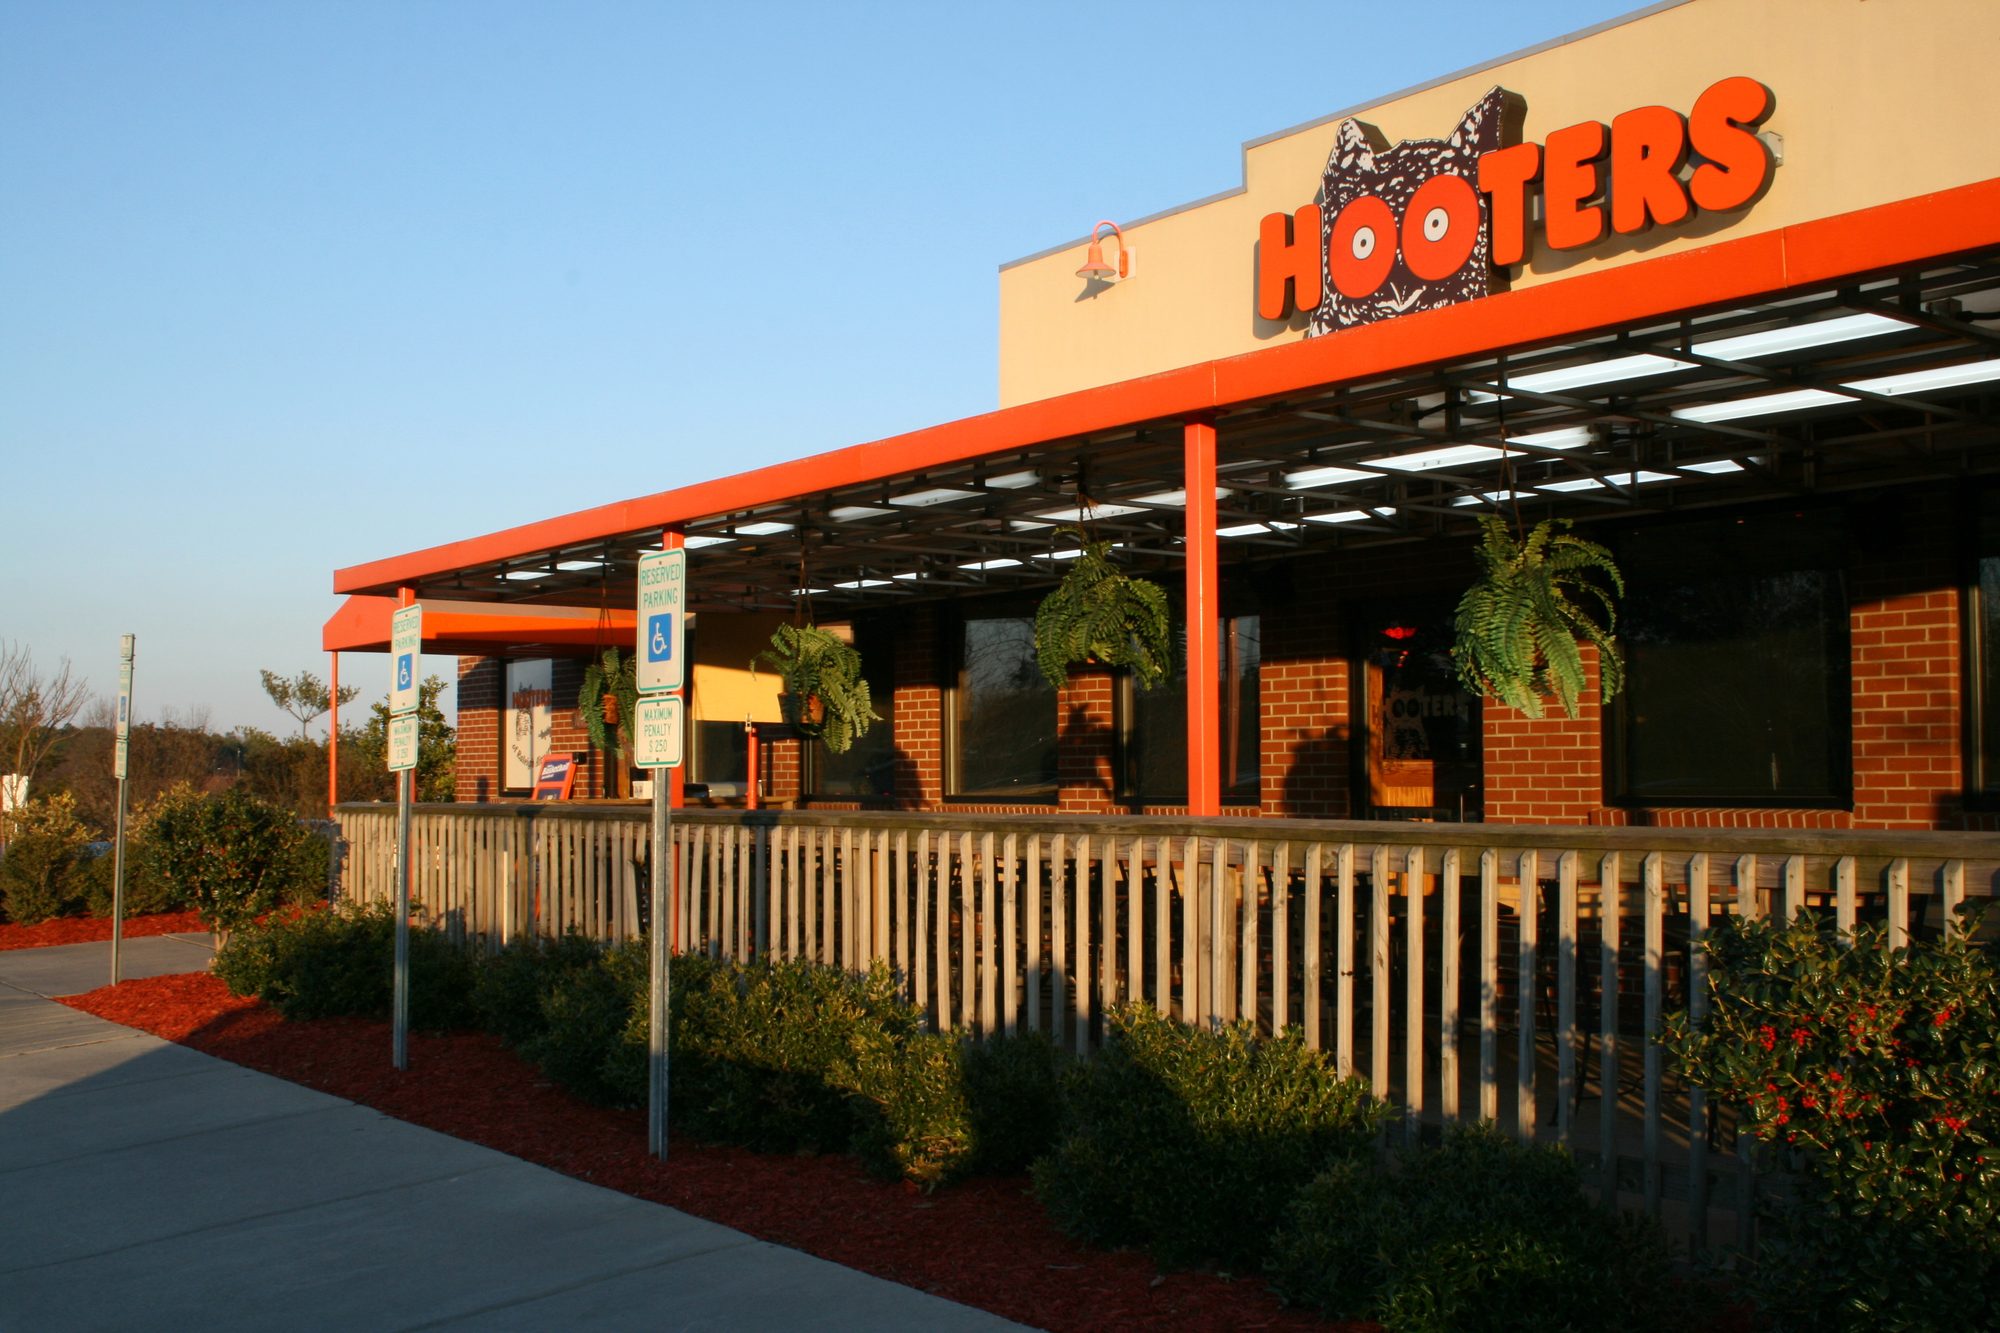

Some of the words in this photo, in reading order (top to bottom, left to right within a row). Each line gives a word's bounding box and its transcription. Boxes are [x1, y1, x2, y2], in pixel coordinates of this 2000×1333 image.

[1258, 76, 1769, 320] HOOTERS
[640, 563, 681, 586] RESERVED
[643, 589, 679, 609] PARKING
[643, 707, 673, 721] MAXIMUM
[644, 723, 672, 737] PENALTY
[655, 739, 668, 752] 250
